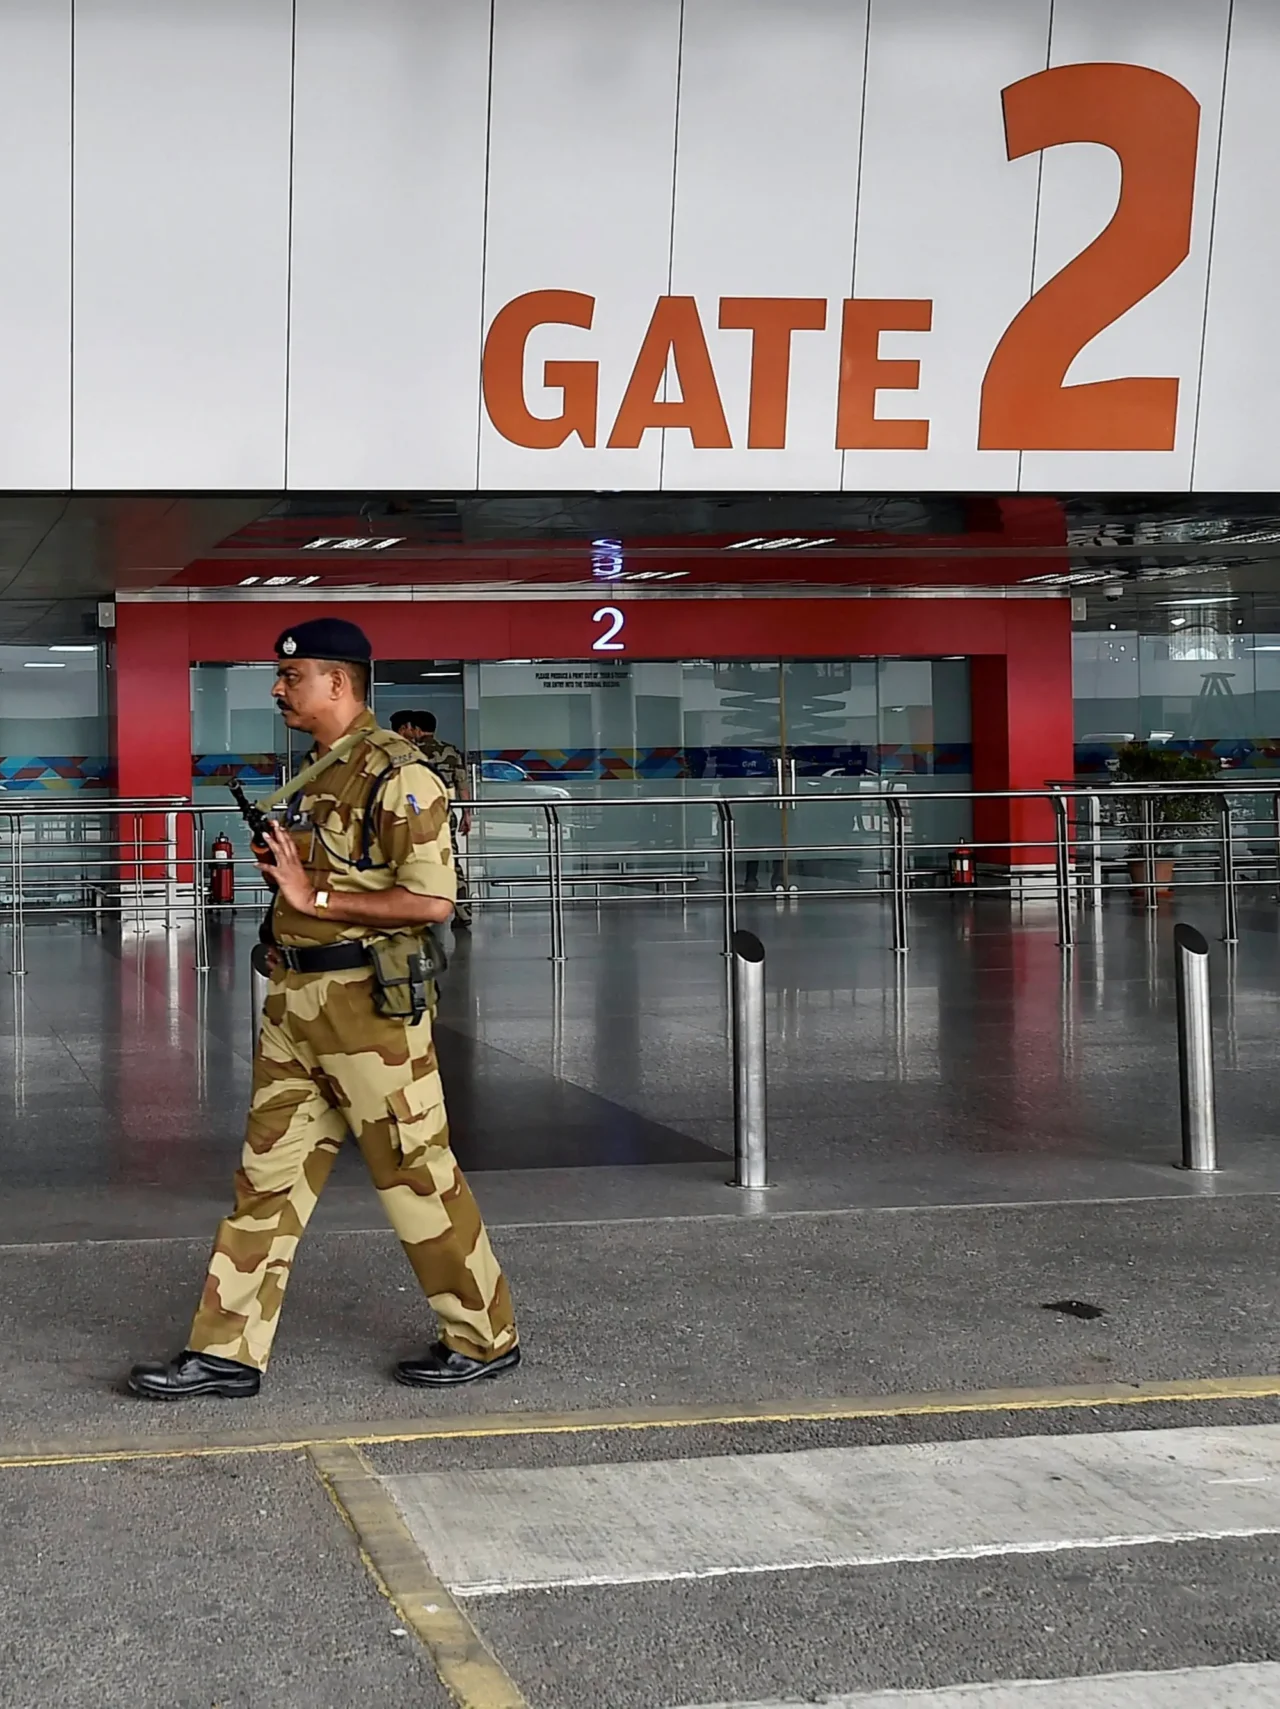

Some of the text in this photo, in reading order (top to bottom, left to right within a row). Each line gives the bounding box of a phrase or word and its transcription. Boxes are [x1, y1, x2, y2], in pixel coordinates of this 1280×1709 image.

[482, 62, 1201, 451] GATE 2
[592, 606, 625, 651] 2
